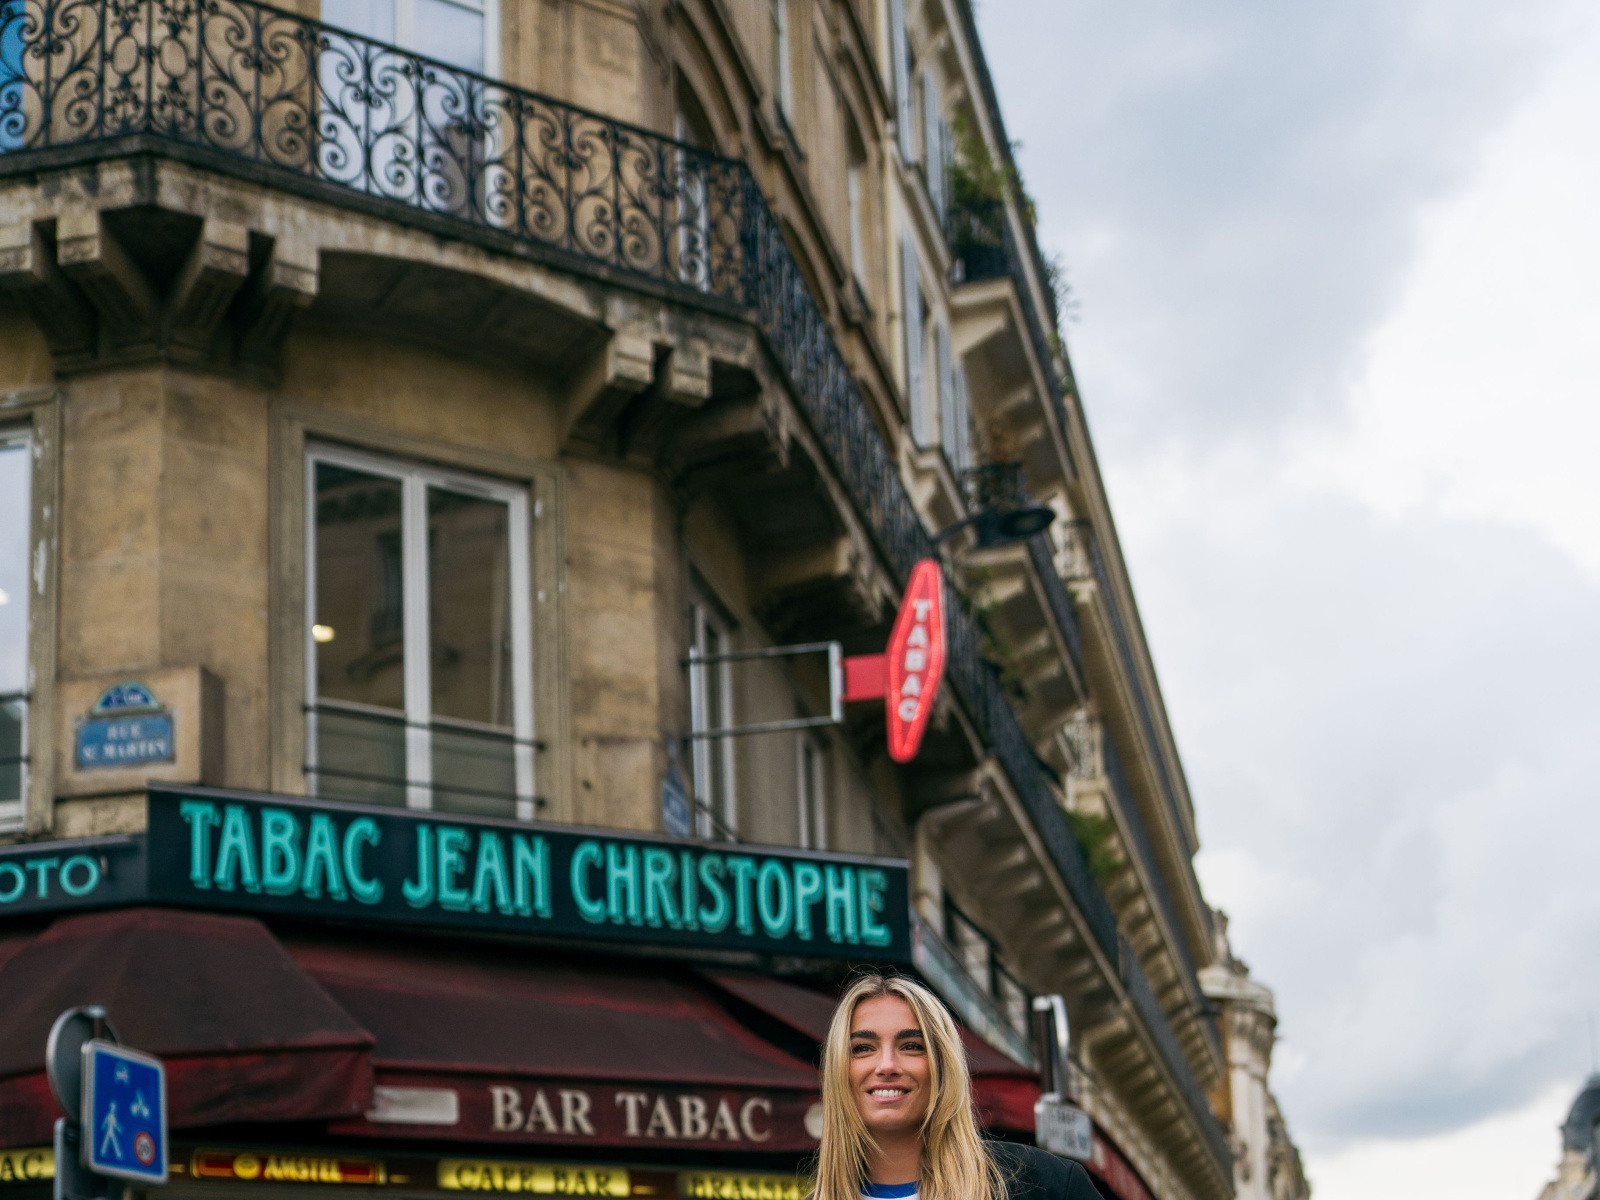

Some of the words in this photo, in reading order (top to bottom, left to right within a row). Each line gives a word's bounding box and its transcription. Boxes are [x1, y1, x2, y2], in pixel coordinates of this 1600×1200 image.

[898, 599, 935, 722] TABAC
[103, 739, 167, 758] MARTIN
[107, 724, 140, 741] RUE
[180, 800, 384, 904] TABAC
[402, 824, 552, 918] JEAN
[570, 840, 892, 947] CHRISTOPHE
[488, 1085, 595, 1136] BAR
[615, 1090, 773, 1142] TABAC
[264, 1155, 343, 1182] AMSTEL
